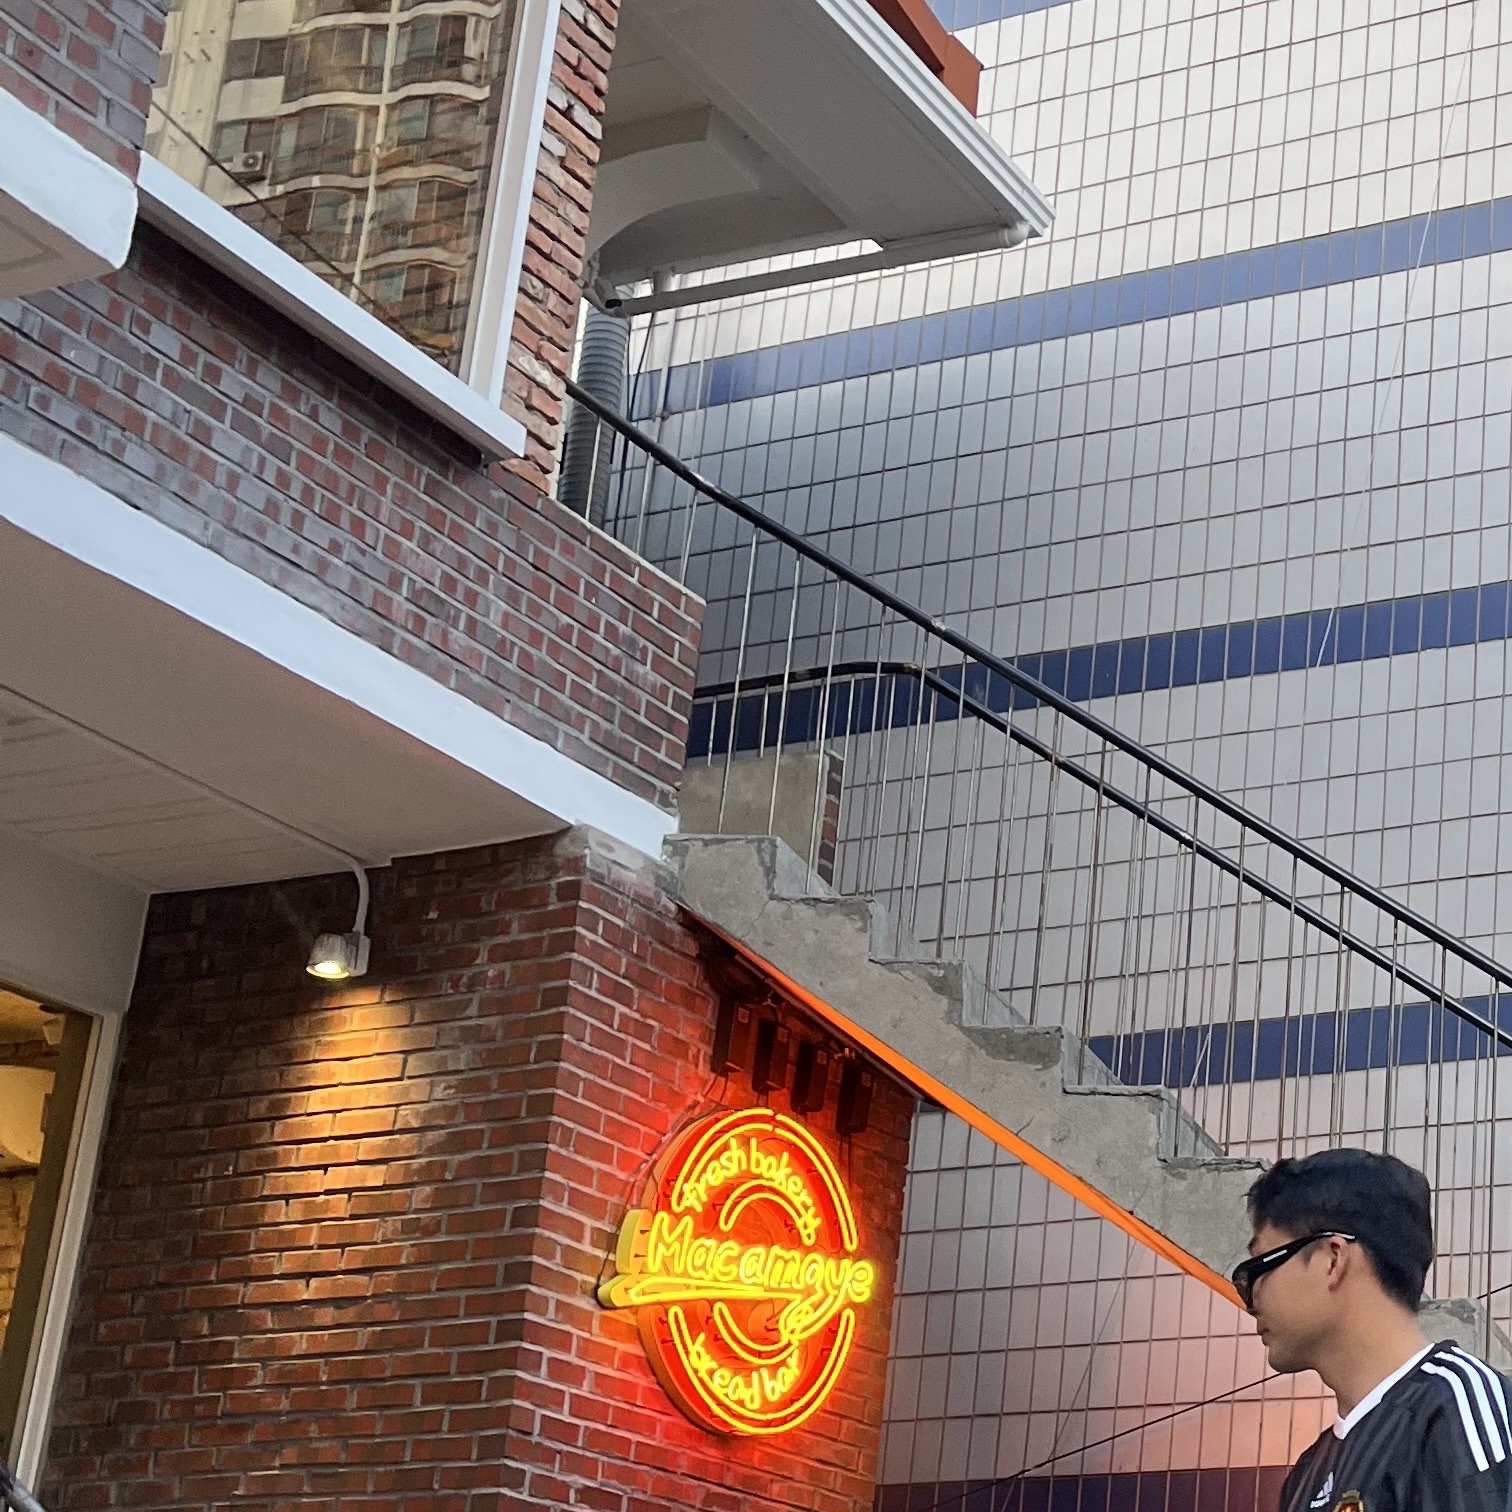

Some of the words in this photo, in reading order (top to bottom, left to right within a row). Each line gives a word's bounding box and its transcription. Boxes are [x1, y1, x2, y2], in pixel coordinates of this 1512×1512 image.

[682, 1137, 748, 1213] fresh
[751, 1137, 822, 1247] bakery
[690, 1332, 761, 1410] bread
[760, 1349, 801, 1403] bar
